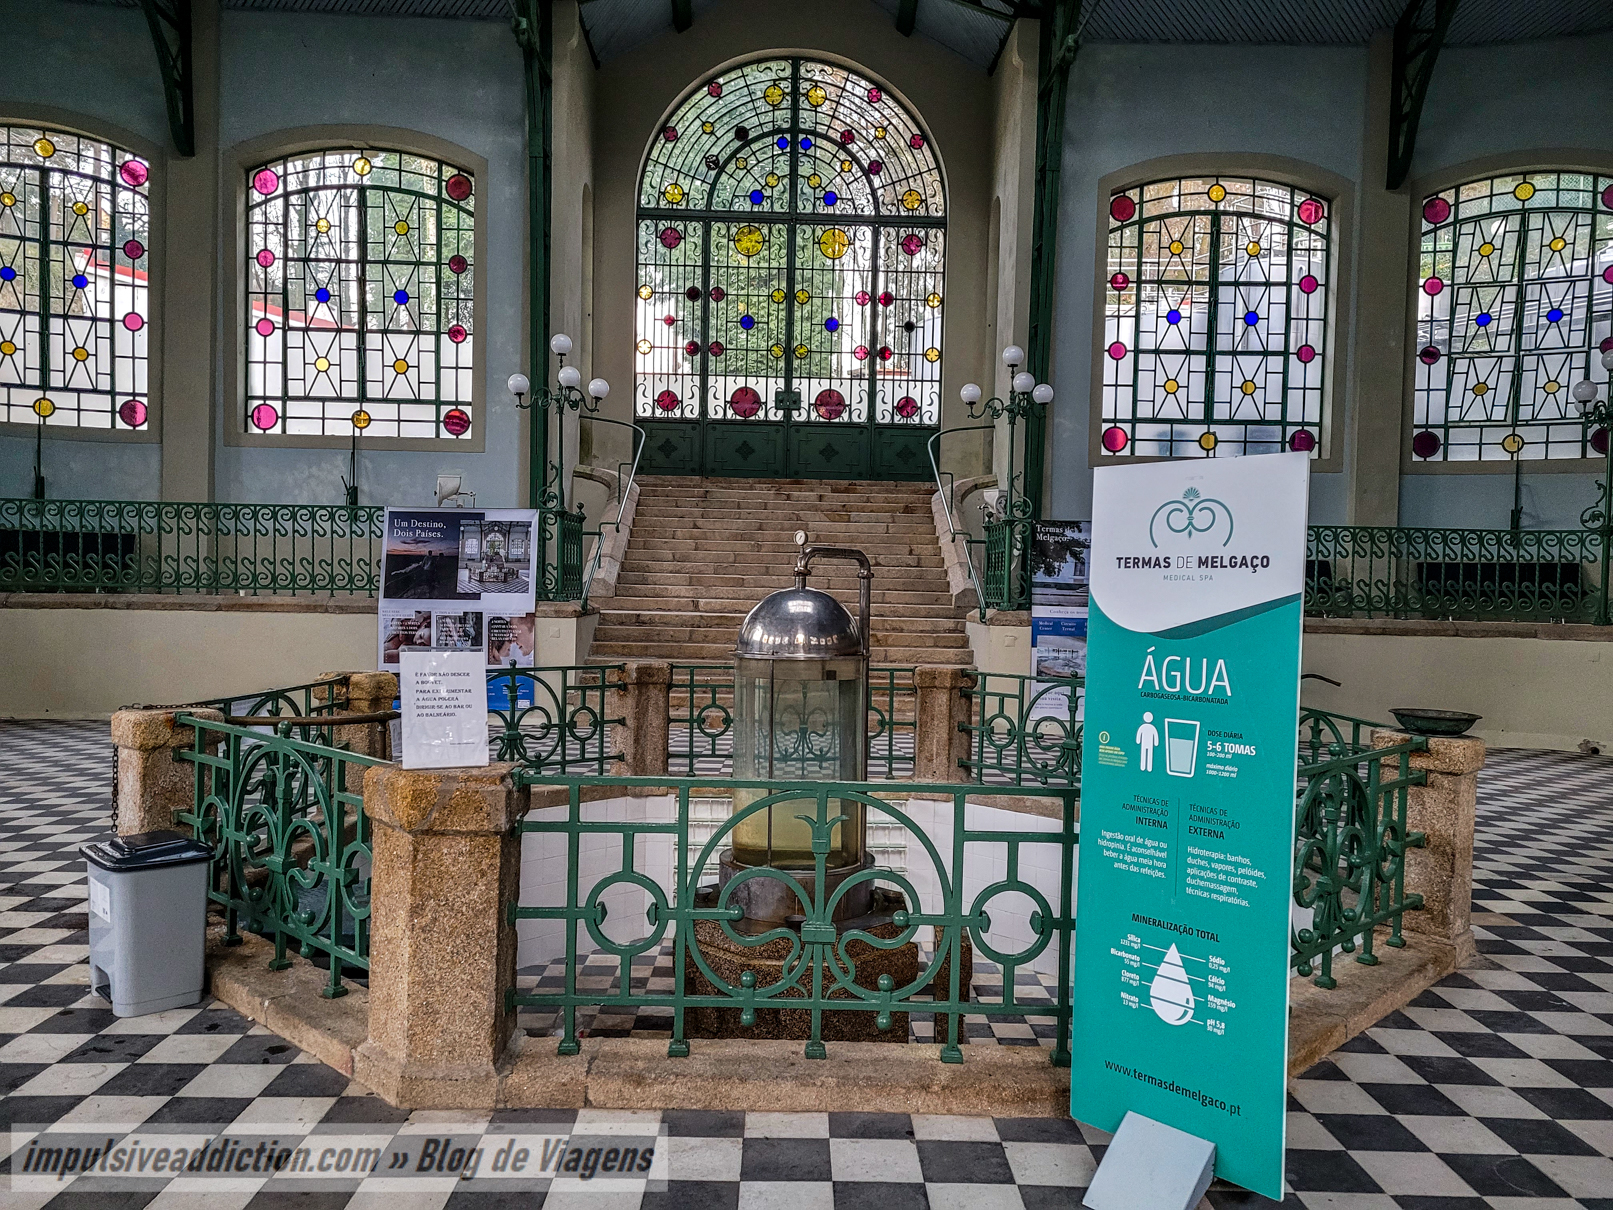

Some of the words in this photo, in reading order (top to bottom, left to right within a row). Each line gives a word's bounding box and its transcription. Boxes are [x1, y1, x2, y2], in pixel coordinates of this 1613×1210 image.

[394, 519, 408, 527] Um
[411, 519, 447, 529] Destino,
[1036, 524, 1063, 533] Termas
[393, 529, 413, 537] Dois
[415, 529, 444, 538] Países.
[1116, 556, 1171, 569] TERMAS
[1176, 555, 1194, 569] DE
[1197, 555, 1271, 574] MELGAÇO
[1138, 646, 1232, 696] ÁGUA
[1207, 729, 1222, 738] DOSE
[1223, 731, 1243, 740] DIÁRIA
[1207, 740, 1222, 752] 5-6
[1223, 742, 1256, 756] TOMAS
[1206, 763, 1224, 771] máximo
[1133, 794, 1160, 806] TÉCNICAS
[1161, 799, 1169, 807] DE
[1122, 803, 1169, 817] ADMINISTRAÇÃO
[1189, 803, 1218, 815] TÉCNICAS
[1219, 808, 1228, 817] DE
[1135, 816, 1168, 829] INTERNA
[1188, 814, 1240, 829] ADMINISTRAÇÃO
[1101, 829, 1124, 840] Ingestão
[1136, 836, 1143, 844] de
[1144, 837, 1158, 848] água
[1159, 841, 1168, 849] ou
[1188, 825, 1225, 840] EXTERNA
[1097, 838, 1125, 851] hidropinia.
[1126, 842, 1131, 851] É
[1131, 845, 1167, 859] aconselhável
[1187, 845, 1226, 860] Hidroterapia:
[1226, 852, 1252, 866] banhos,
[1103, 848, 1119, 859] beber
[1123, 852, 1137, 863] água
[1138, 857, 1152, 866] meia
[1153, 859, 1167, 869] hora
[1113, 861, 1129, 871] antes
[1129, 864, 1139, 873] das
[1140, 866, 1166, 879] refeições.
[1186, 856, 1210, 868] duches,
[1211, 861, 1236, 874] vapores,
[1237, 866, 1267, 880] pelóides,
[1186, 866, 1217, 879] aplicações
[1218, 872, 1226, 881] de
[1227, 875, 1258, 889] contraste,
[1186, 876, 1239, 895] duchemassagem,
[1185, 886, 1210, 898] técnicas
[1210, 892, 1251, 907] respiratórias.
[1131, 913, 1194, 936] MINERALIZAÇÃO
[1195, 928, 1220, 943] TOTAL
[1110, 947, 1141, 962] Bicarbonato
[1208, 955, 1226, 966] Sódio
[1121, 969, 1140, 981] Cloreto
[1208, 974, 1226, 986] Cálcio
[1120, 991, 1139, 1003] Nitrato
[1207, 994, 1236, 1009] Magnésio
[1104, 1059, 1242, 1117] www.termasdemelgaco.pt
